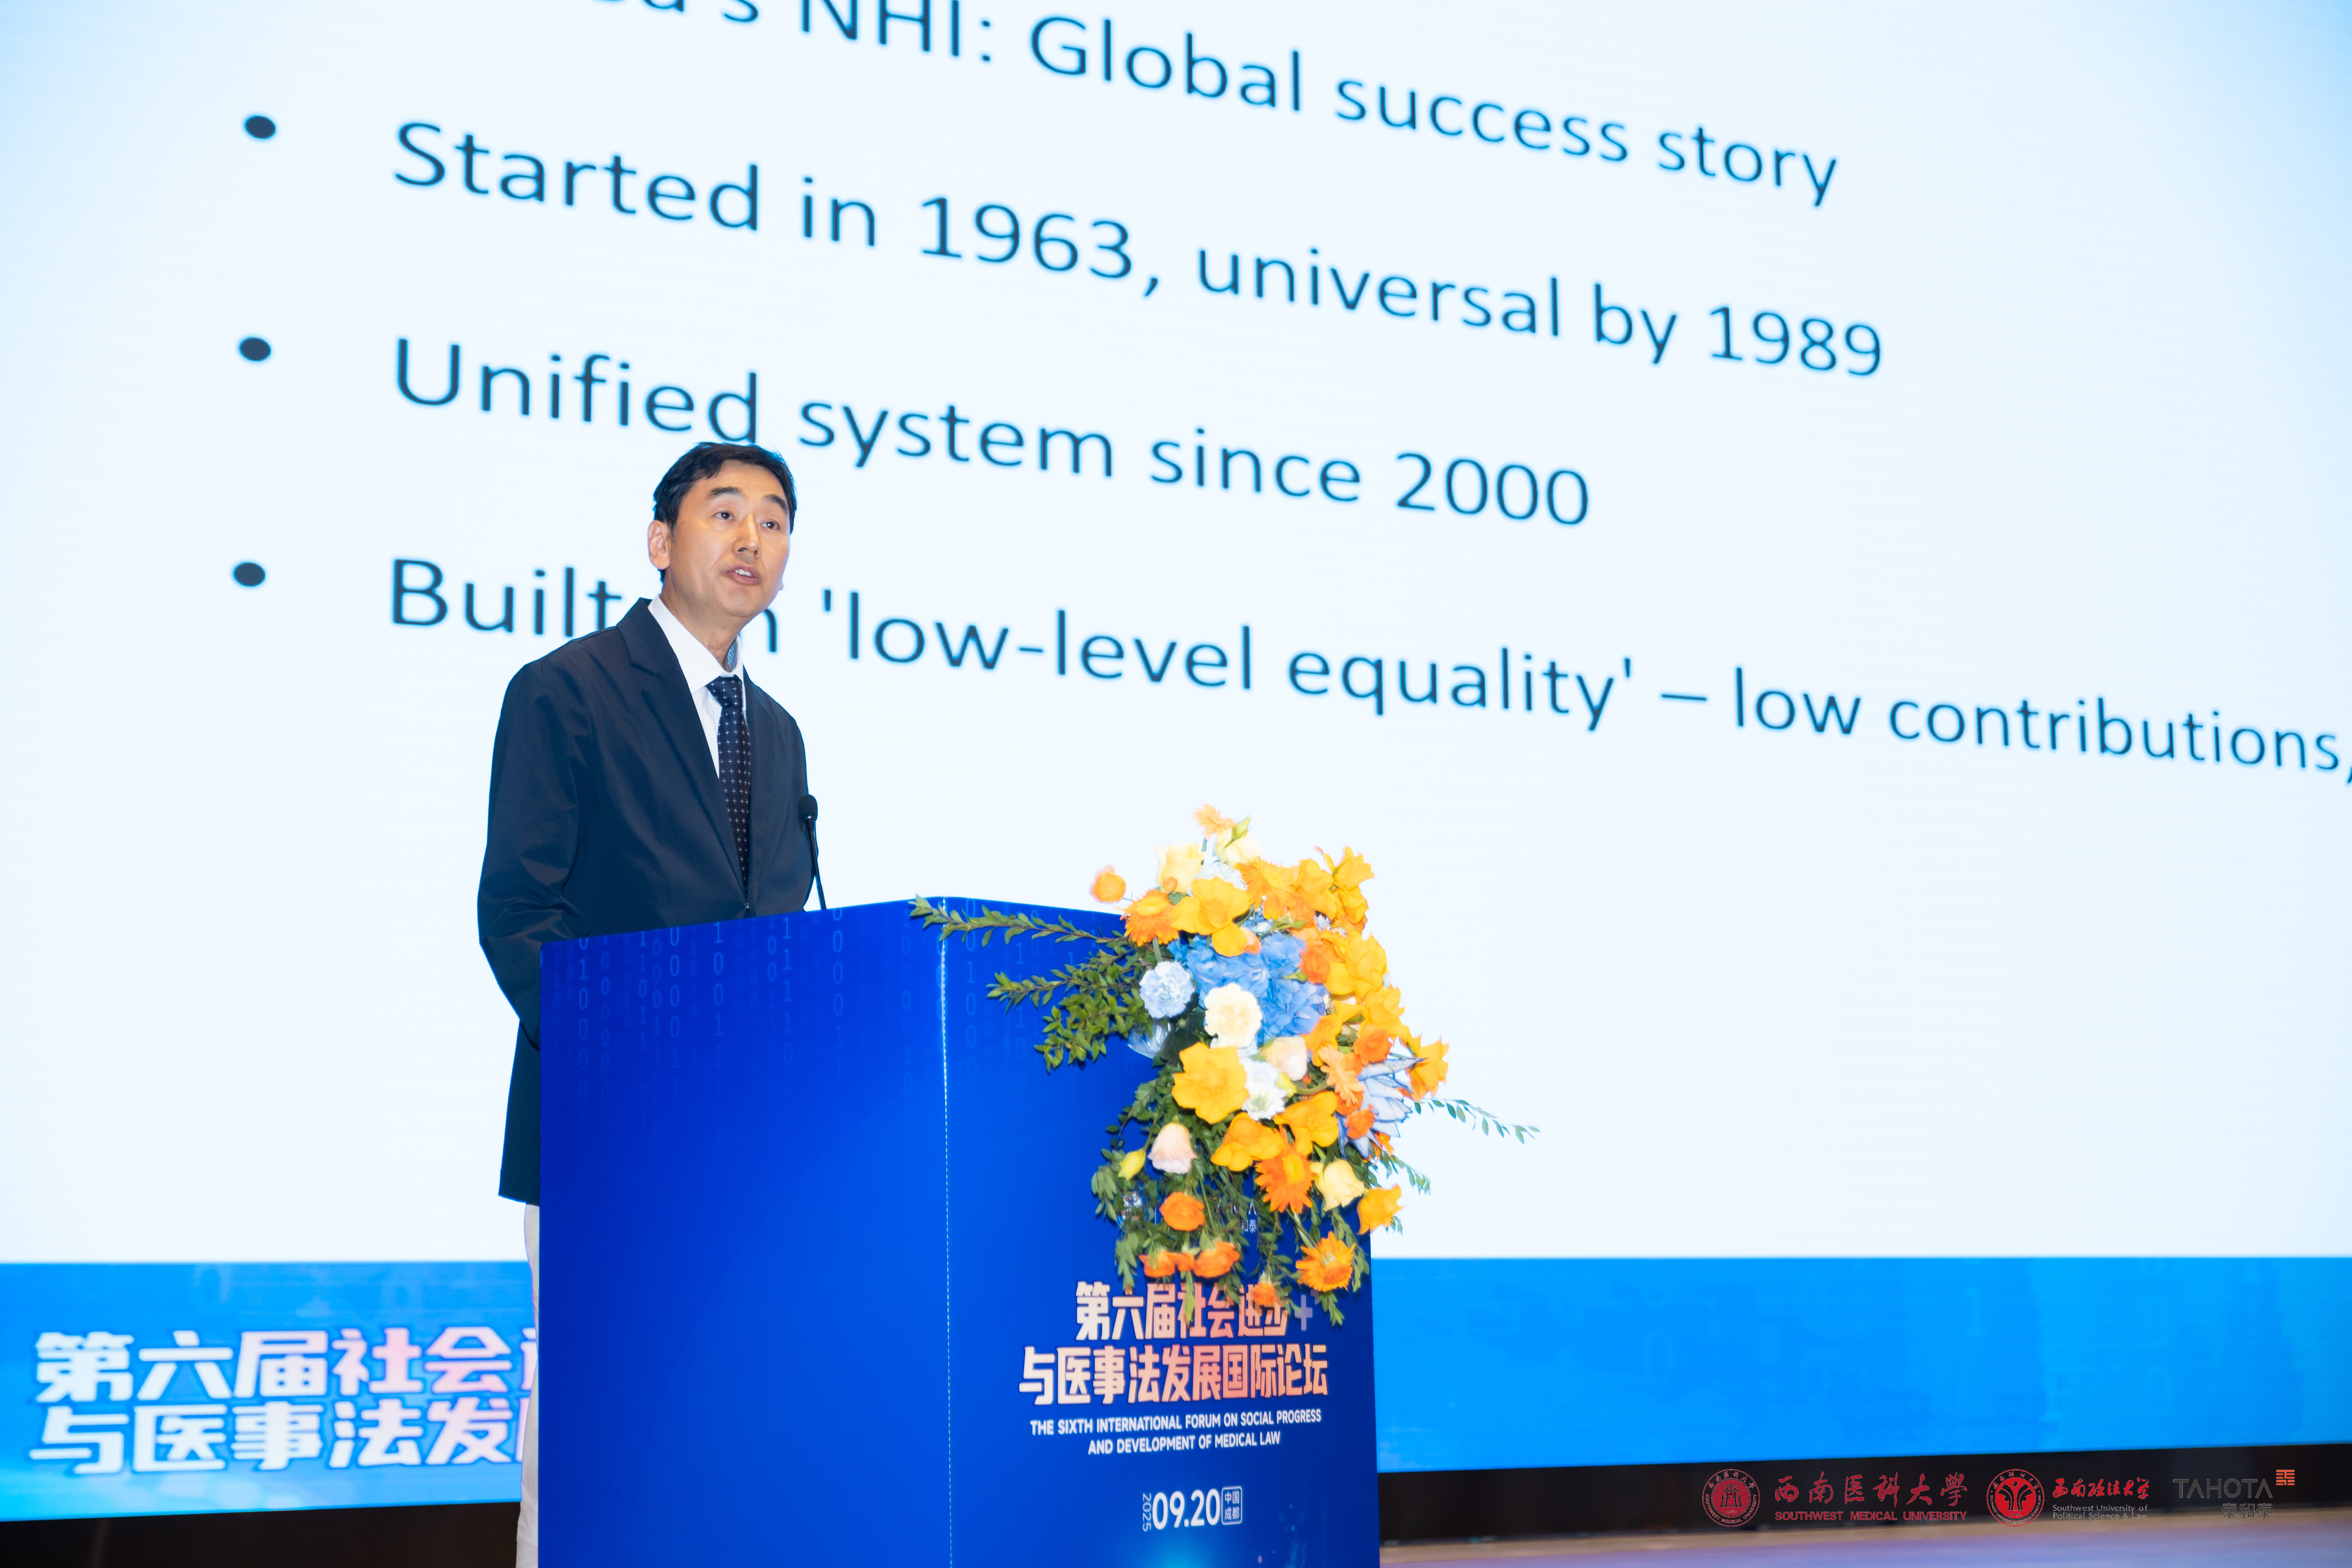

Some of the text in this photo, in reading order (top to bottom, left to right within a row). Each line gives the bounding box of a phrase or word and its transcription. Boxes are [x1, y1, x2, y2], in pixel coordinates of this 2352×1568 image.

[1030, 15, 1301, 113] Global
[1336, 80, 1629, 163] success
[1658, 126, 1838, 208] story
[394, 122, 1882, 377] Started in 1963, universal by 1989
[396, 337, 1589, 526] Unified system since 2000
[392, 558, 622, 639] Built
[822, 588, 1251, 691] 'low-level
[1288, 646, 1632, 732] equality'
[1735, 666, 1862, 736] low
[1019, 1344, 1328, 1405] 与医事法发展国际论坛
[29, 1396, 530, 1475] 与医事法发
[1030, 1408, 1322, 1436] THE SIXTH INTERNATIONAL FORUM ON SOCIAL PROGRESS
[1088, 1430, 1281, 1455] AND DEVELOPMENT OF MEDICAL LAW
[1142, 1493, 1152, 1532] 2025
[1152, 1488, 1221, 1530] 09.20
[1225, 1491, 1240, 1505] 中国
[1225, 1507, 1240, 1521] 成都
